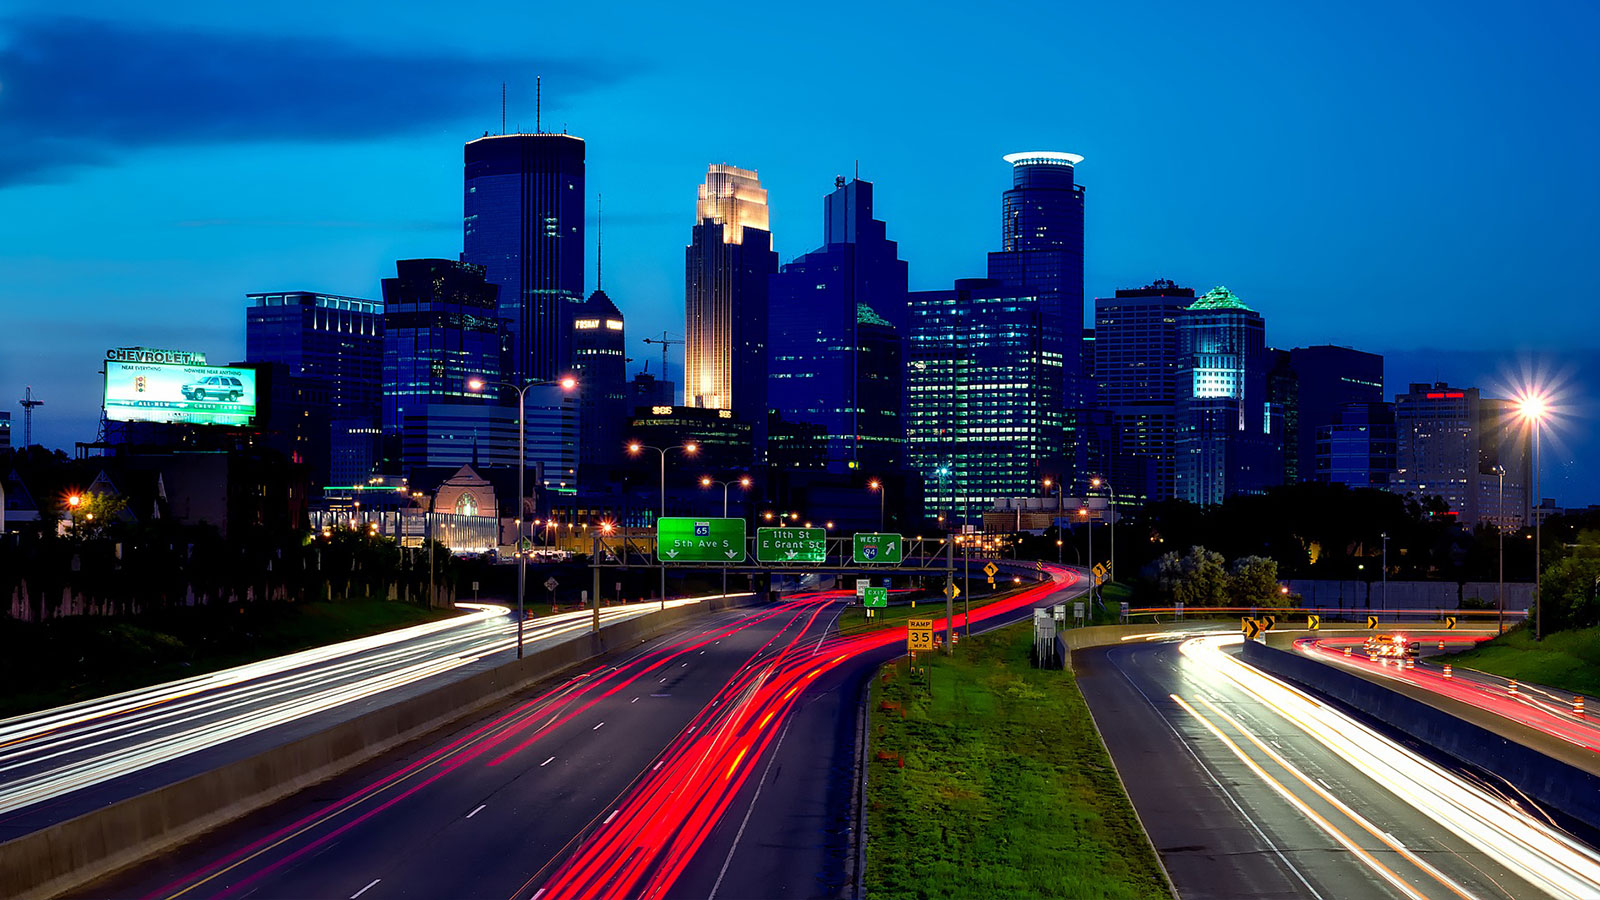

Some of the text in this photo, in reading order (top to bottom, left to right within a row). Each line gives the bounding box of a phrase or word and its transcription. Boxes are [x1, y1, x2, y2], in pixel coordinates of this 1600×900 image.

[106, 349, 190, 364] CHEVROLET
[696, 527, 708, 535] 65
[773, 531, 810, 539] 11th St
[674, 539, 729, 547] 5th Ave S
[763, 540, 820, 549] E Grant St
[865, 548, 875, 556] 94
[911, 632, 930, 642] 35
